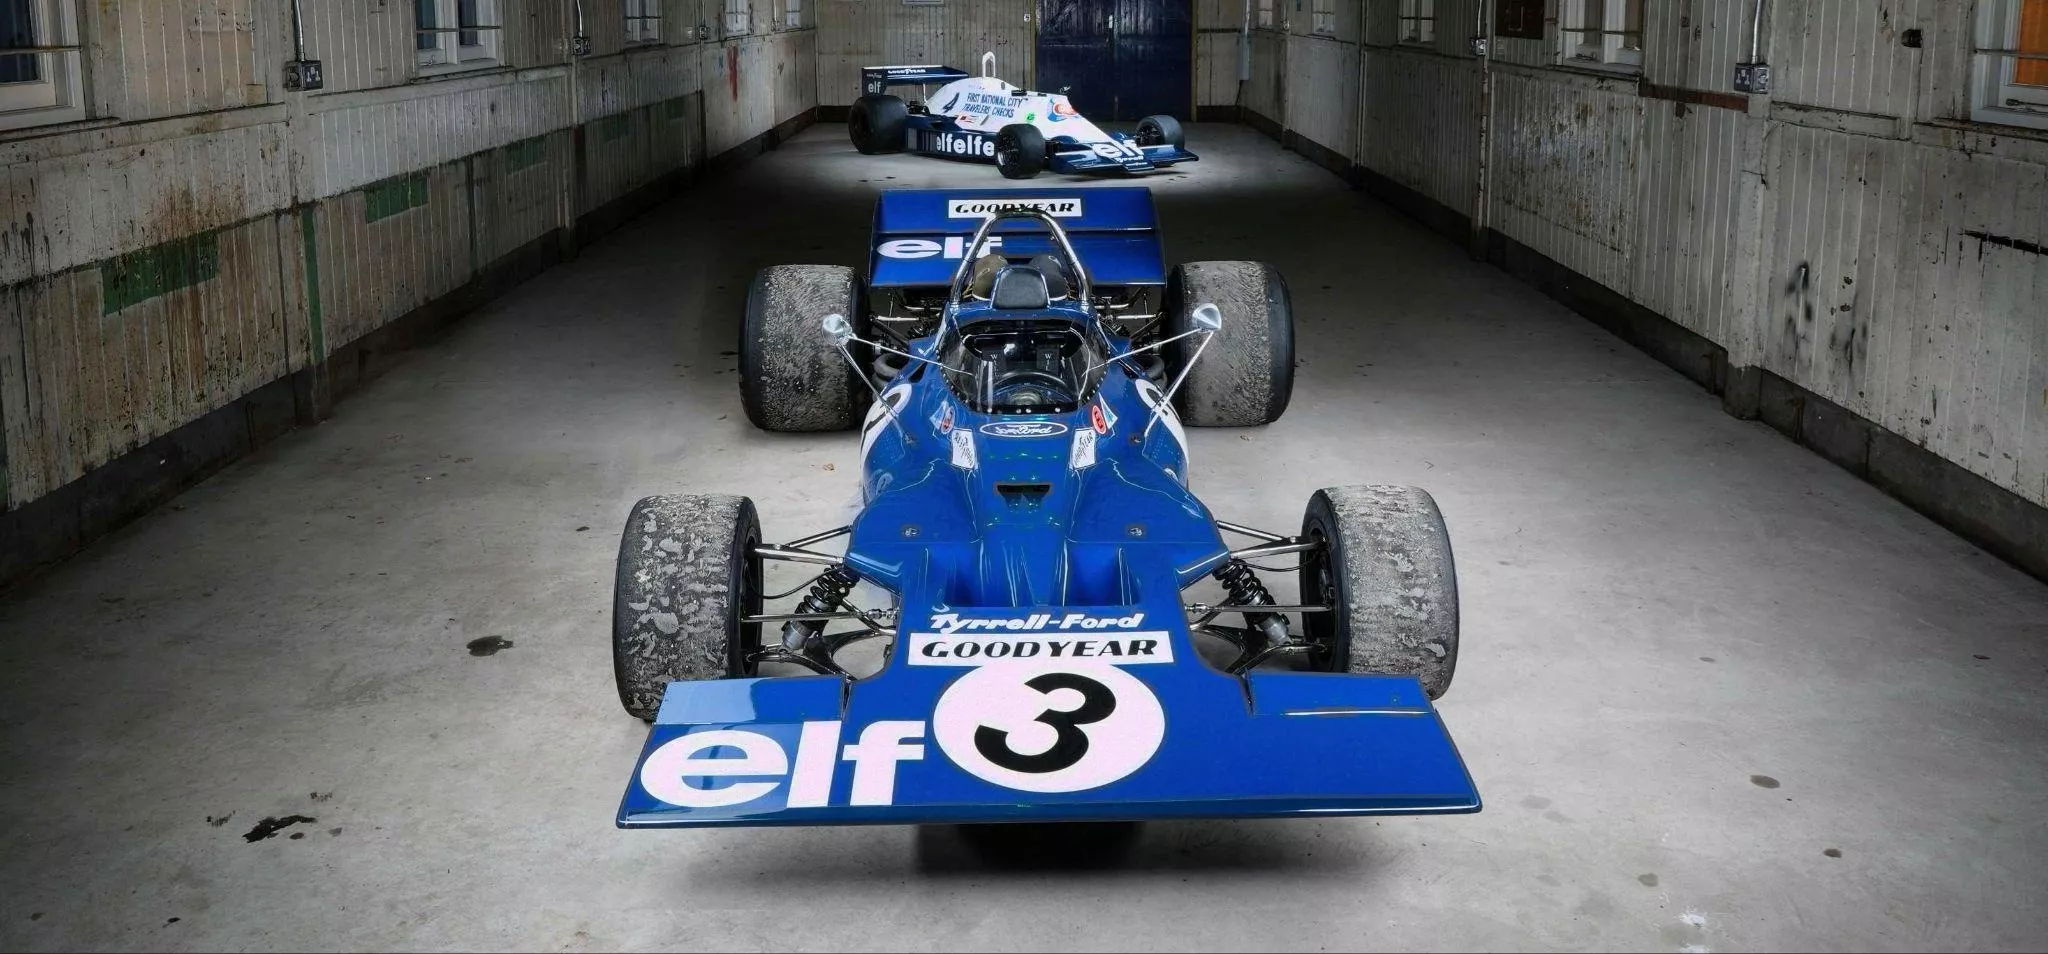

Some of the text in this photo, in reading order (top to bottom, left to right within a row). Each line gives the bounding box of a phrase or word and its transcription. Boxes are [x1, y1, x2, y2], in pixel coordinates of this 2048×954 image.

[868, 81, 882, 94] elf
[967, 93, 1023, 108] FIRST NATIONAL CITY
[962, 103, 1014, 118] TRAVELERS CHECKS
[1092, 140, 1144, 158] elf
[930, 613, 1145, 632] Tyrrell-Ford
[921, 639, 1158, 659] GOODYEAR
[974, 672, 1117, 774] 3
[640, 720, 925, 808] elf
